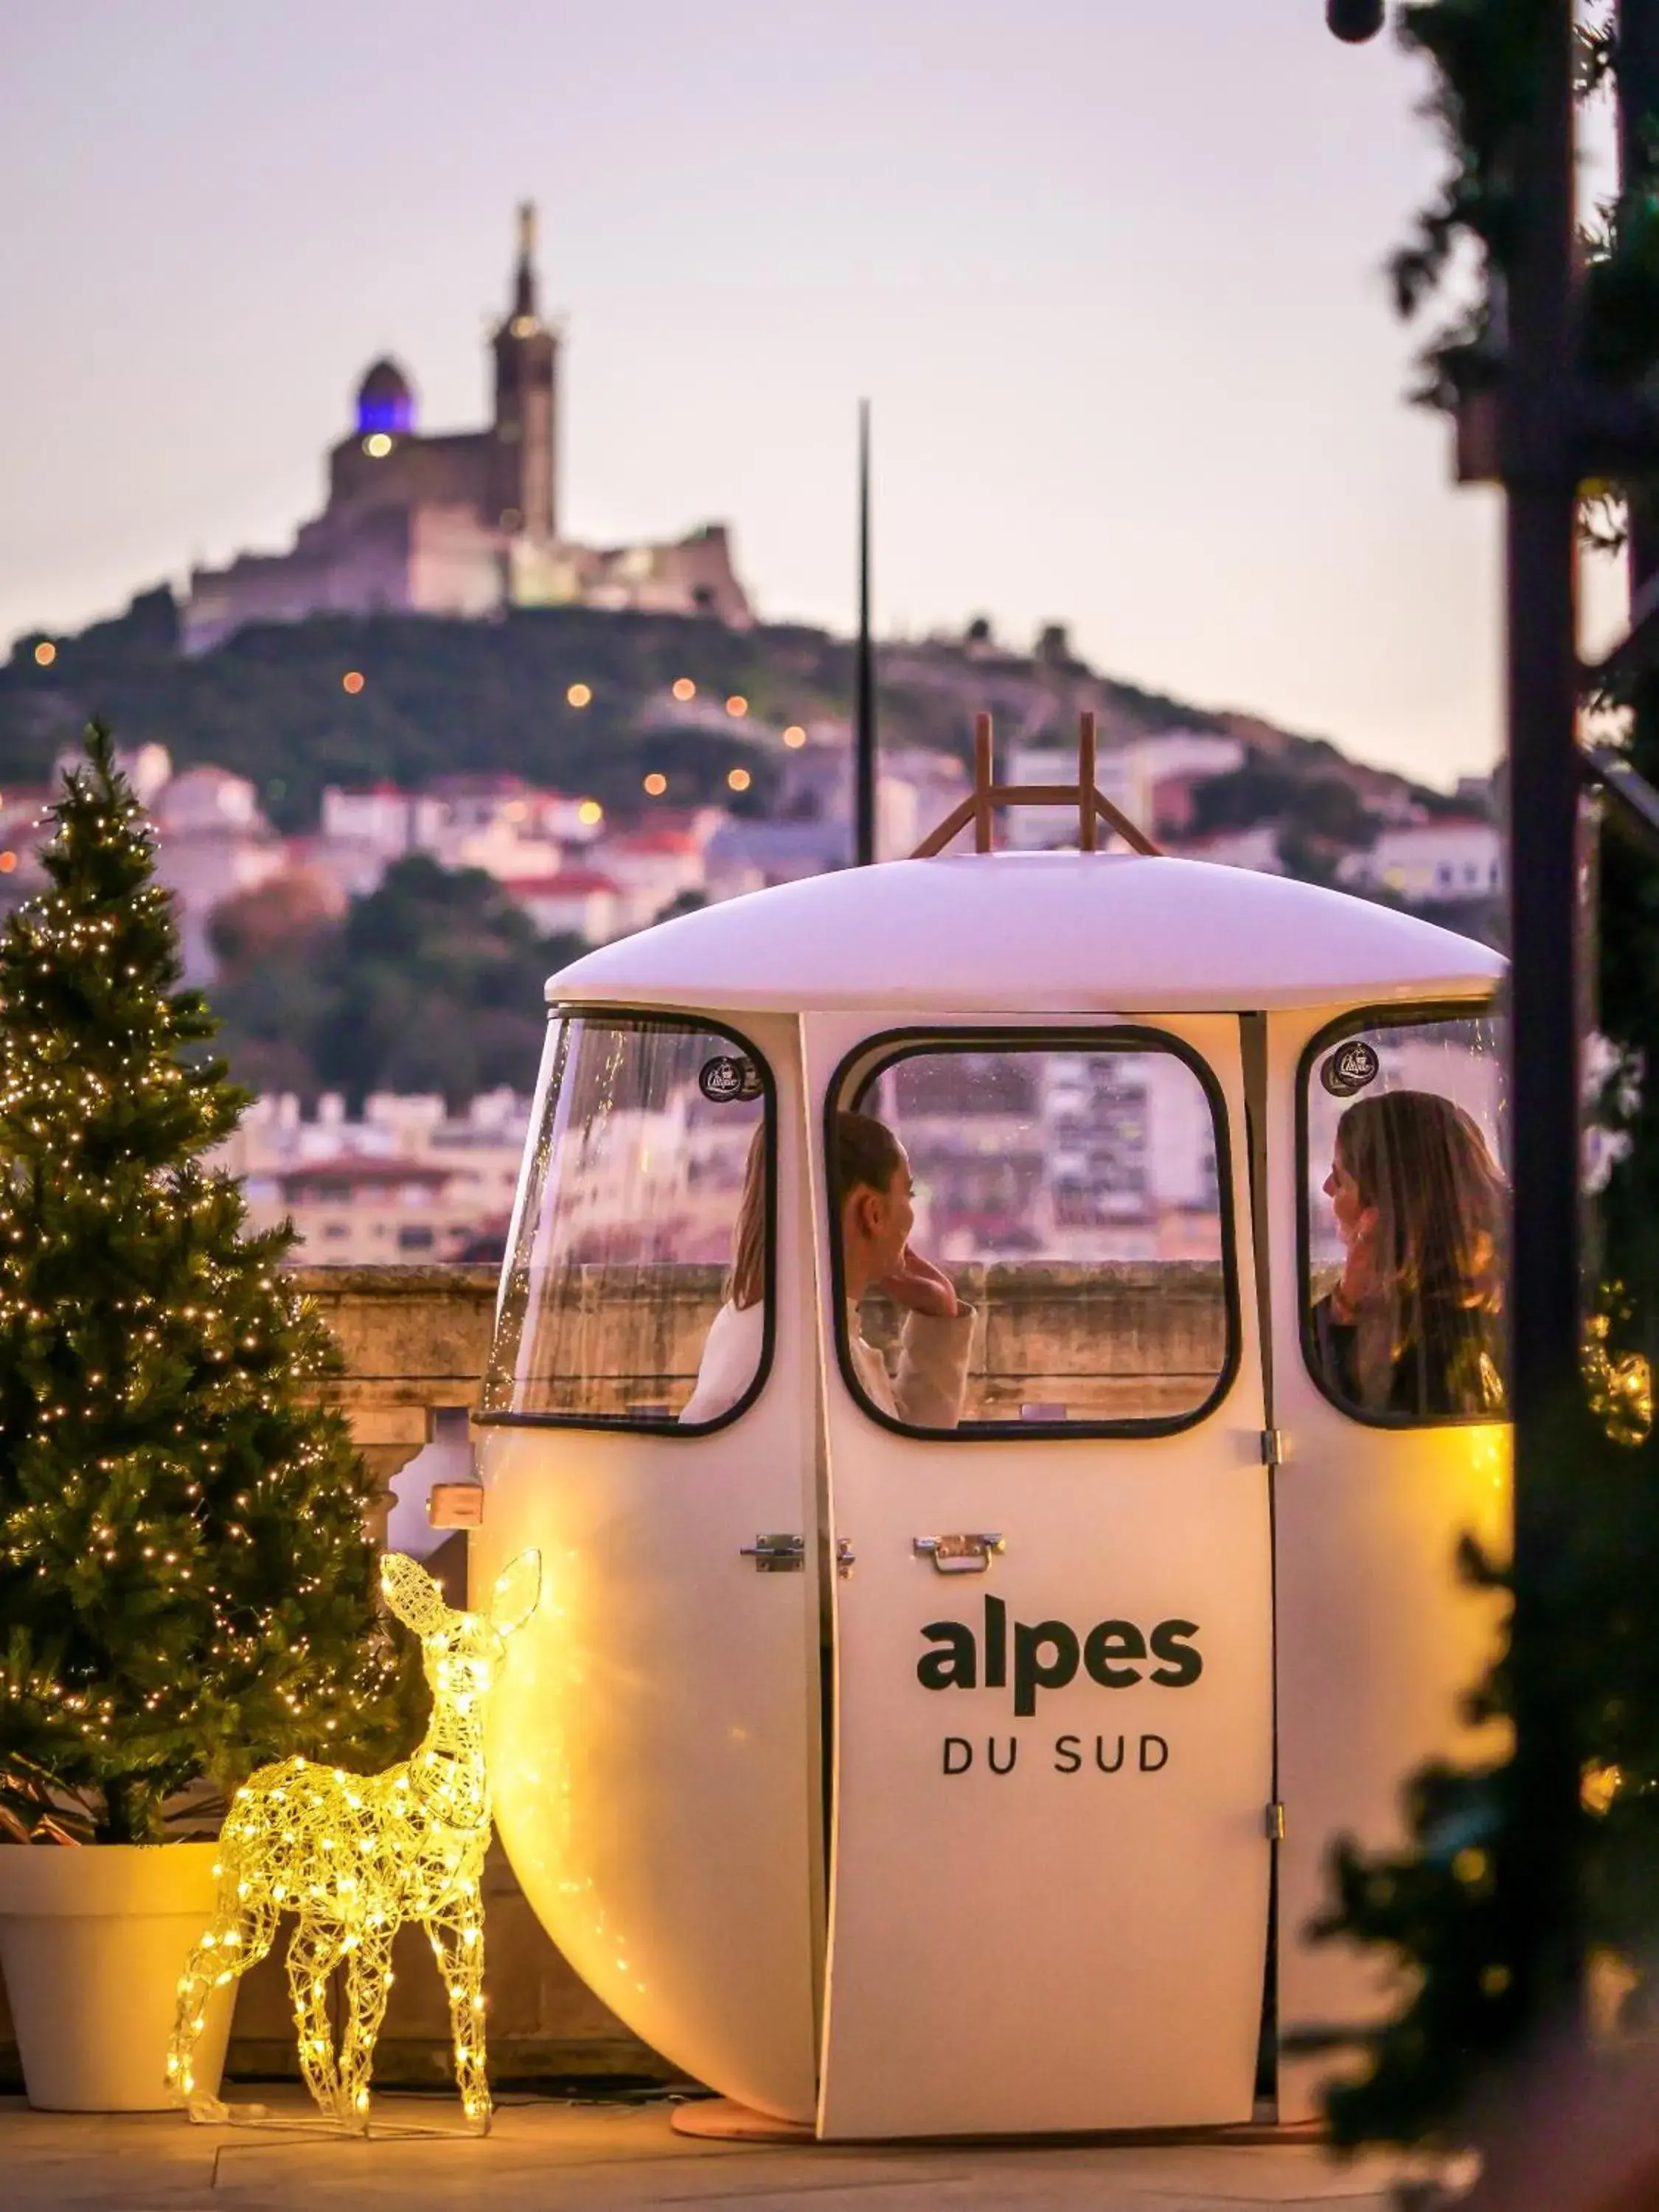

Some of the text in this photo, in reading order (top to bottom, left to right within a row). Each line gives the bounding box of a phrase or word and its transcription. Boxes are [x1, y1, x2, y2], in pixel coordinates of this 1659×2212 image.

[917, 1593, 1203, 1717] alpes
[942, 1734, 1169, 1775] DU SUD
